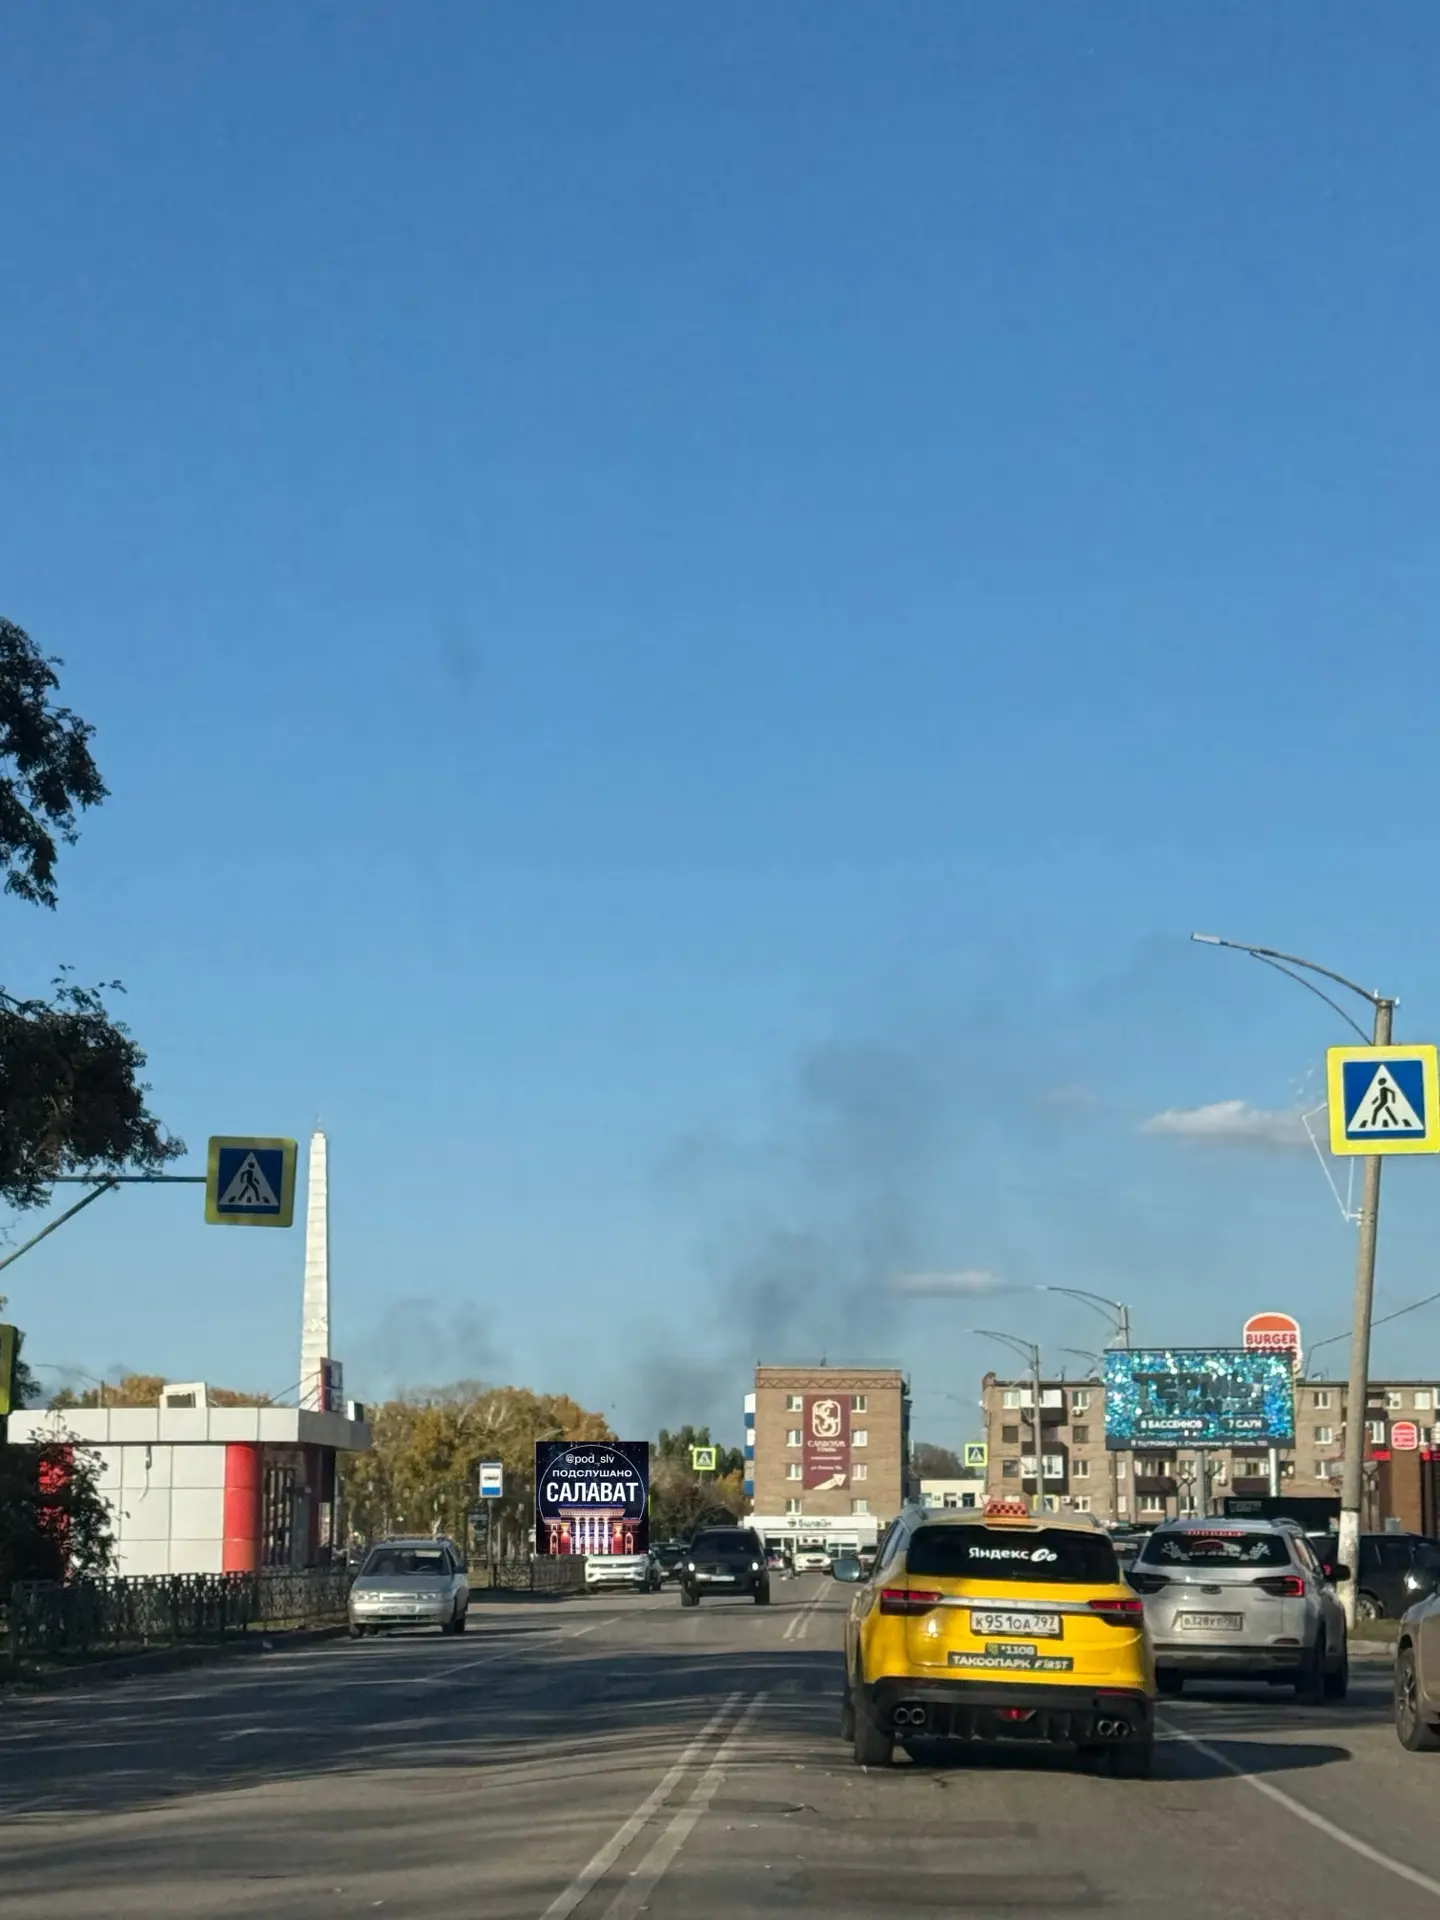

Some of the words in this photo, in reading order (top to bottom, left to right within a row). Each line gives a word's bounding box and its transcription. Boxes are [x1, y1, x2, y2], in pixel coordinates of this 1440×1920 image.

[1246, 1333, 1297, 1345] BURGER
[968, 1546, 1030, 1560] Яндекс
[951, 1655, 1031, 1669] ТАКСОПАРК
